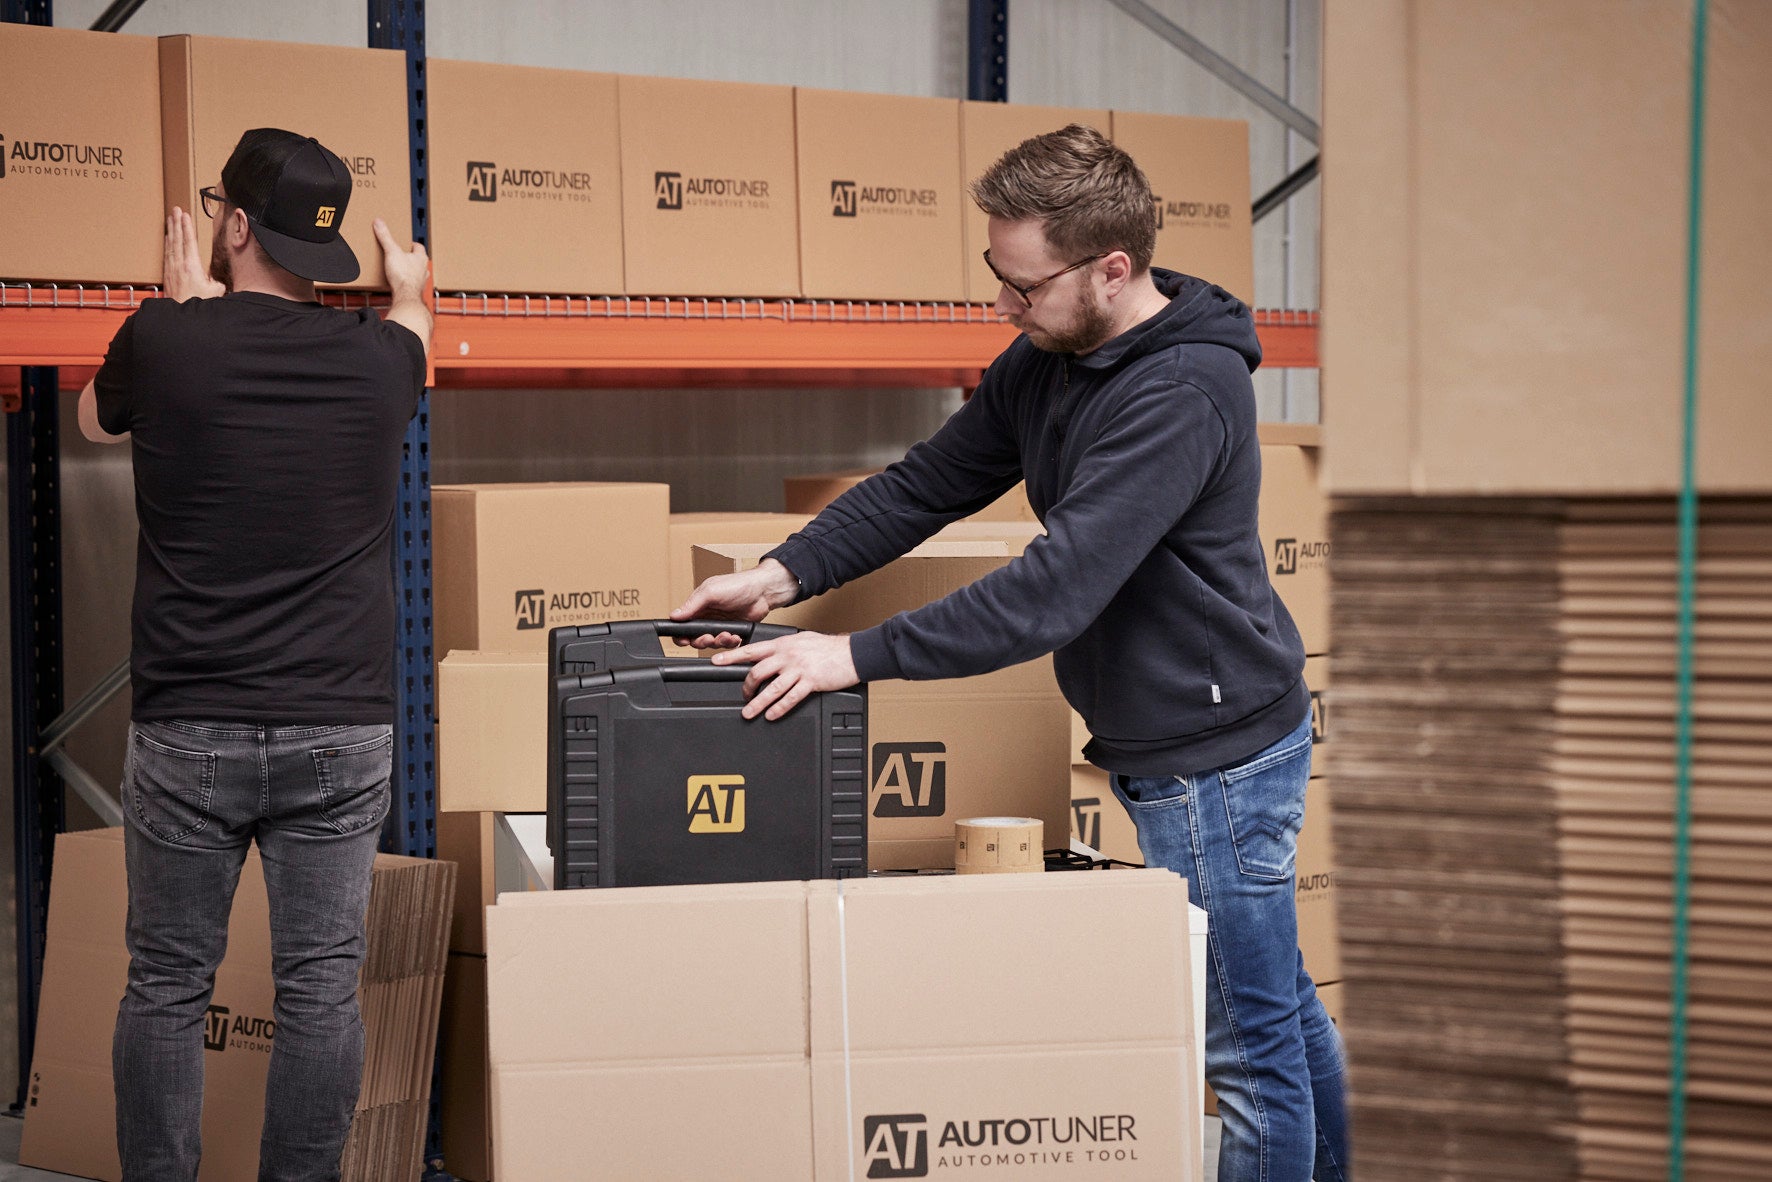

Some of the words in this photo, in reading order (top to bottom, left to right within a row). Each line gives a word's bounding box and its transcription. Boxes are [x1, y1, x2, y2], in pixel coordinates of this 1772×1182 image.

[11, 141, 123, 166] AUTOTUNER
[11, 165, 88, 177] AUTOMOTIVE
[95, 169, 124, 179] TOOL
[467, 164, 497, 199] AT
[501, 168, 591, 190] AUTOTUNER
[501, 190, 563, 200] AUTOMOTIVE
[655, 175, 682, 207] AT
[686, 179, 769, 197] AUTOTUNER
[831, 184, 856, 213] AT
[860, 186, 937, 205] AUTOTUNER
[317, 209, 335, 224] AT
[1275, 542, 1297, 571] AT
[515, 593, 545, 626] AT
[549, 589, 641, 611] AUTOTUNER
[549, 612, 612, 623] AUTOMOTIVE
[616, 610, 641, 618] TOOL
[871, 751, 947, 808] AT
[687, 783, 746, 824] AT
[231, 1015, 276, 1040] AUTO
[938, 1115, 1137, 1148] AUTOTUNER
[864, 1121, 928, 1171] AT
[938, 1151, 1074, 1168] AUTOMOTIVE
[1086, 1149, 1138, 1162] TOOL
